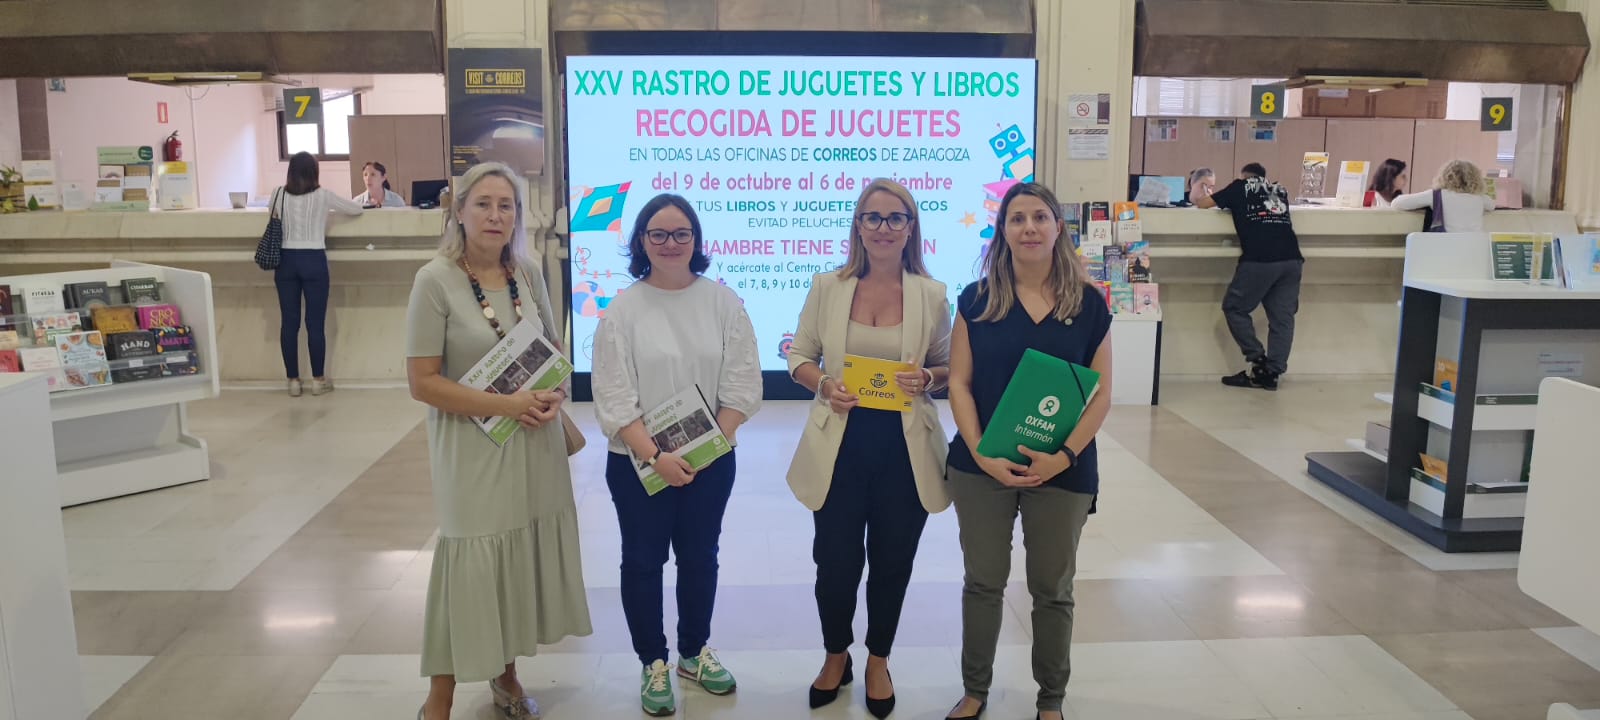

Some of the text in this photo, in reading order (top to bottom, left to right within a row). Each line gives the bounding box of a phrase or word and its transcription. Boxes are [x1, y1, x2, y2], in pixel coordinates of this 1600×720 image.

[468, 72, 483, 84] VISIT
[574, 69, 1020, 98] XXV RASTRO DE JUGUETES Y LIBROS
[295, 95, 312, 118] 7
[1260, 92, 1276, 115] 8
[1489, 103, 1506, 125] 9
[636, 108, 961, 138] RECOGIDA DE JUGUETES
[630, 147, 970, 163] EN TODAS LAS OFICINAS DE CORREOS DE ZARAGOZA
[652, 173, 677, 191] del
[684, 174, 694, 191] 9
[700, 172, 720, 191] de
[726, 172, 792, 191] octubre
[799, 172, 814, 191] al
[820, 173, 829, 191] 6
[835, 172, 855, 191] de
[696, 201, 722, 212] TUS
[726, 201, 775, 212] LIBROS
[780, 201, 788, 212] Y
[749, 217, 853, 228] EVITAD PELUCHES
[781, 239, 834, 256] TIENE
[717, 262, 723, 273] Y
[727, 261, 770, 273] acércate
[774, 262, 783, 273] al
[787, 261, 820, 273] Centro
[738, 278, 747, 289] el
[750, 279, 759, 290] 7,
[761, 279, 770, 291] 8,
[772, 279, 779, 289] 9
[781, 280, 787, 291] y
[789, 278, 801, 289] 10
[121, 340, 150, 351] HAND
[858, 387, 895, 399] Correos
[1025, 415, 1056, 432] OXFAM
[1014, 424, 1054, 444] Intermón
